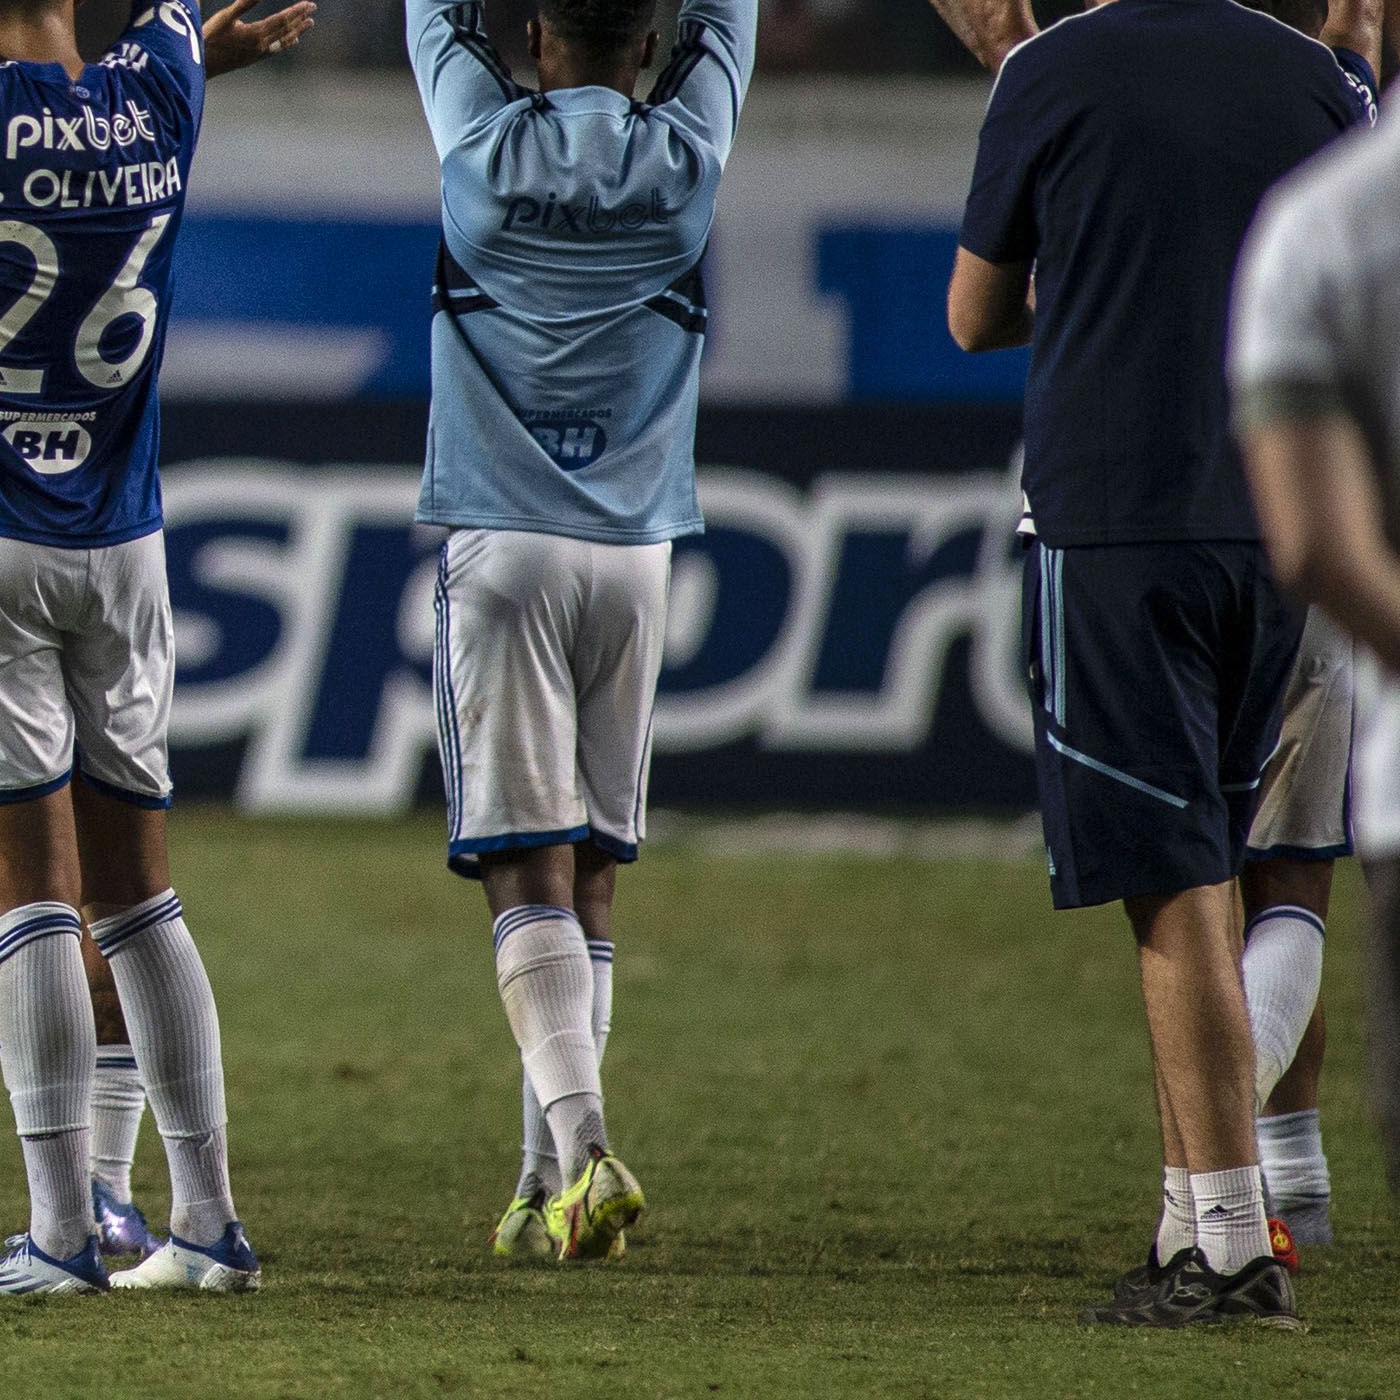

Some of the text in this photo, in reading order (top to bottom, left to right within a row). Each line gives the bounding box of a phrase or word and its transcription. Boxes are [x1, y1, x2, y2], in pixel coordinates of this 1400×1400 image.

[6, 100, 156, 159] pixbet
[24, 160, 183, 208] OLIVEIRA
[501, 187, 670, 233] pixbet
[12, 429, 81, 461] BH
